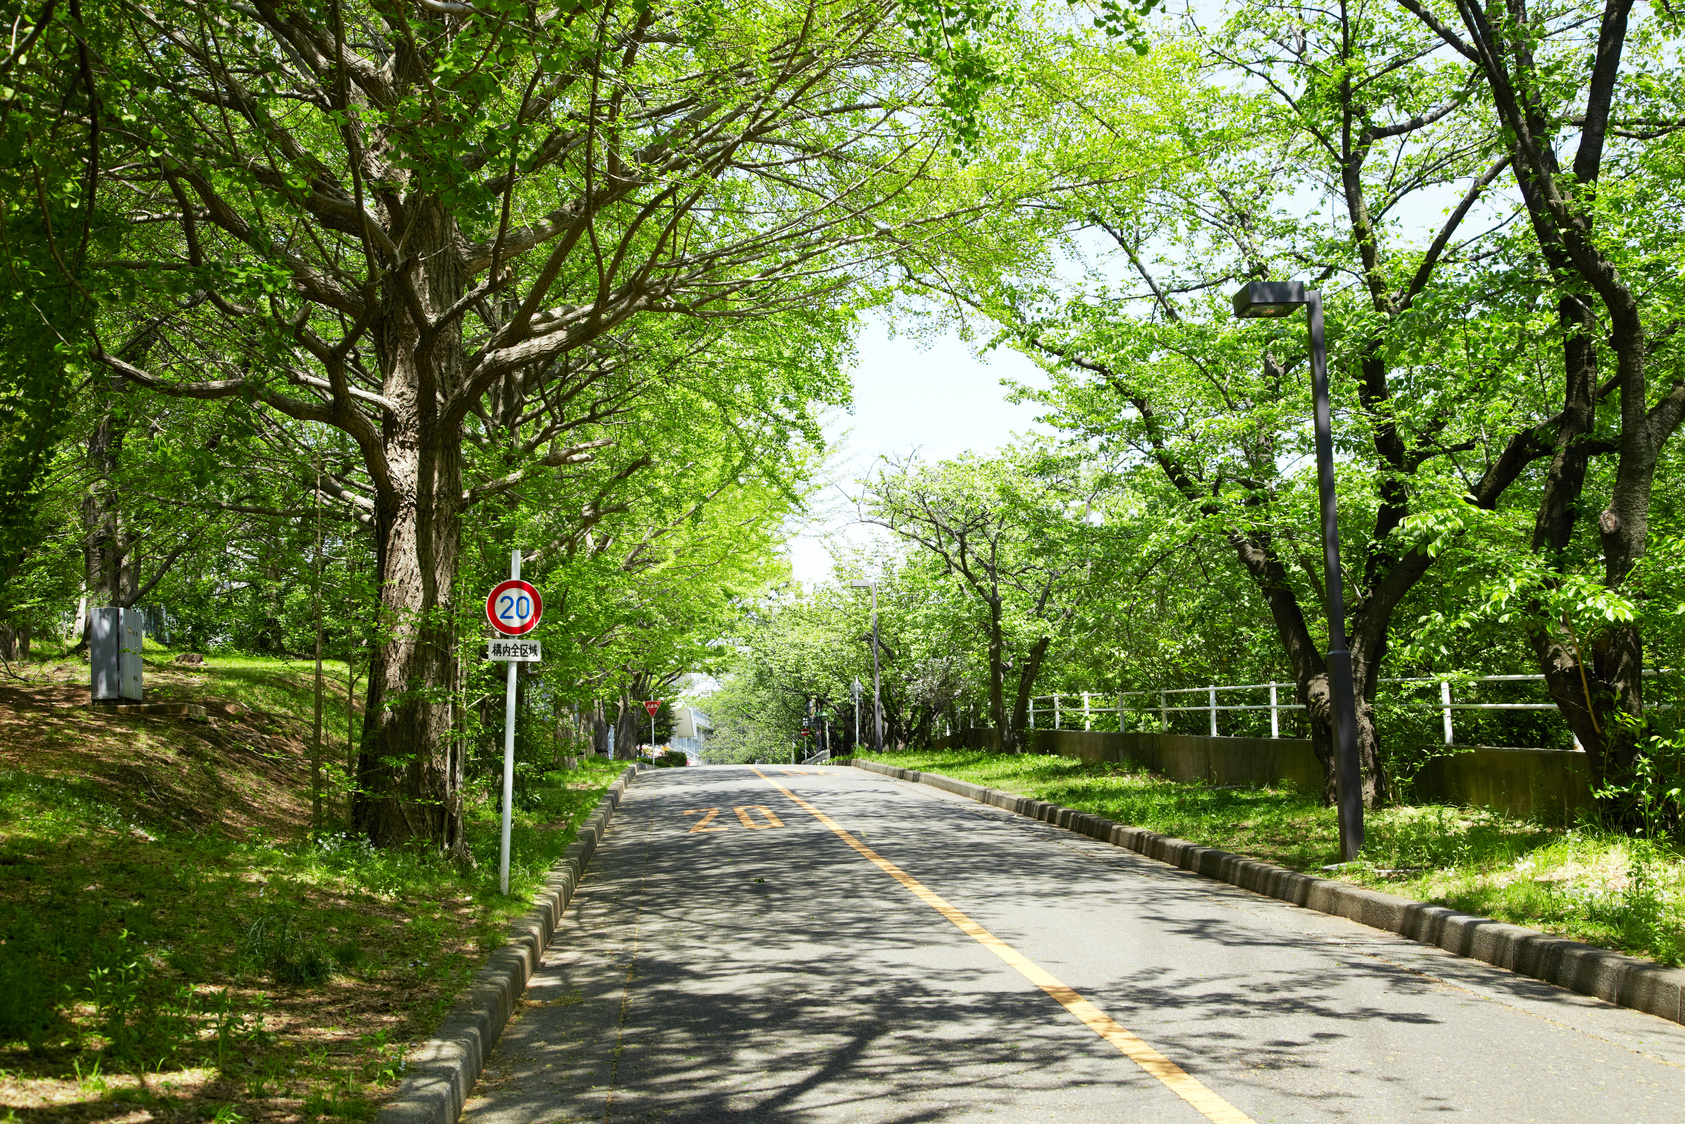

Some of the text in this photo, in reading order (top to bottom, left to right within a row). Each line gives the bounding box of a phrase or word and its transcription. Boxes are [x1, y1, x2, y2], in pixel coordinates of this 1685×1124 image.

[500, 596, 530, 619] 20
[492, 643, 538, 657] 構内全区域
[683, 805, 786, 833] 20
